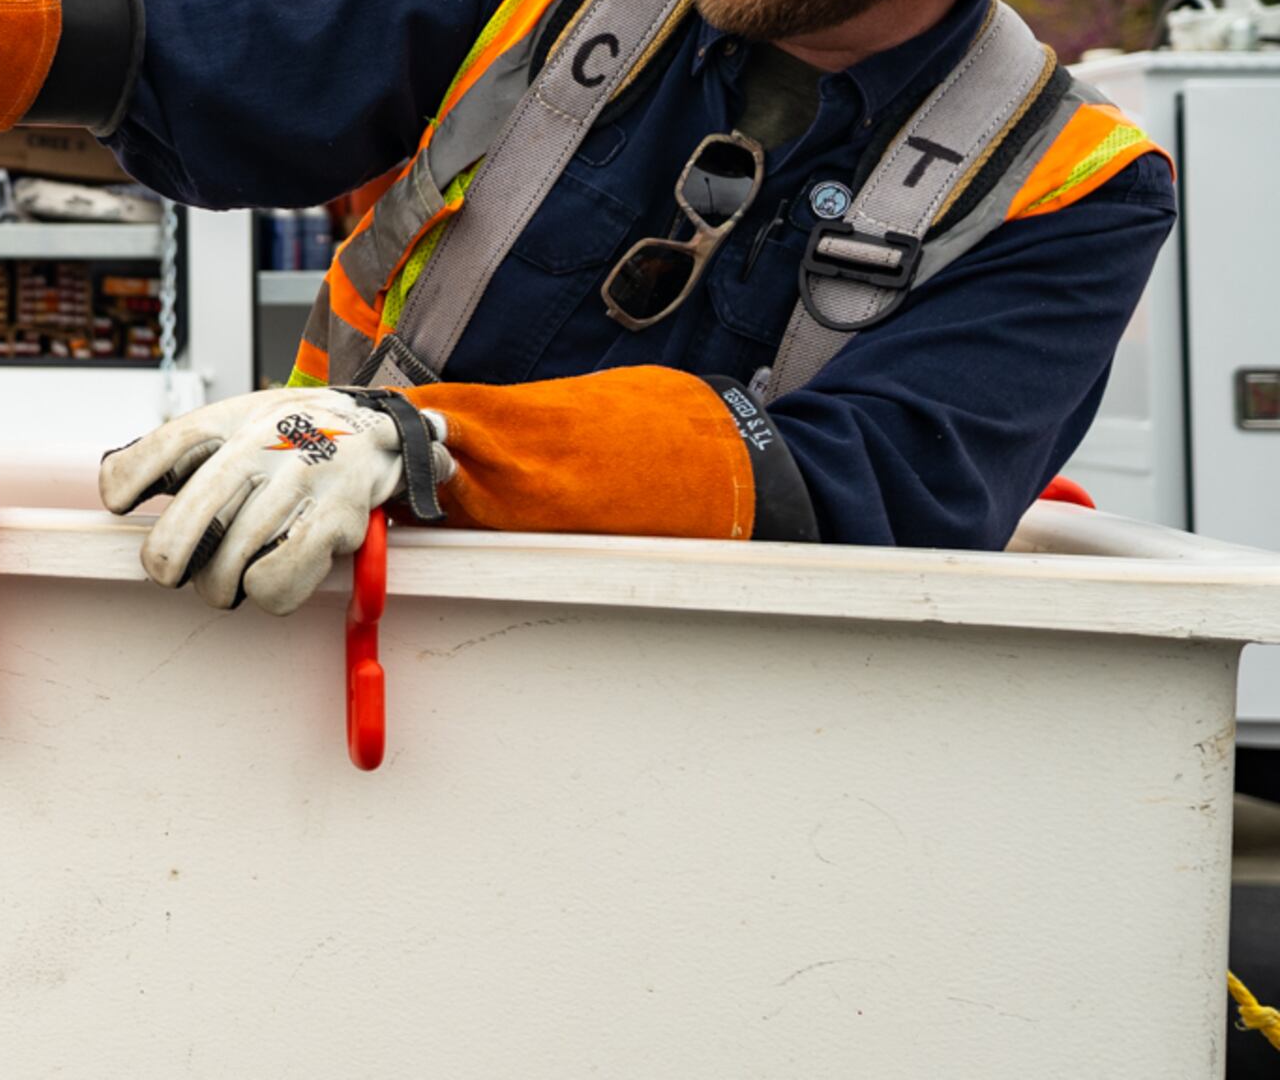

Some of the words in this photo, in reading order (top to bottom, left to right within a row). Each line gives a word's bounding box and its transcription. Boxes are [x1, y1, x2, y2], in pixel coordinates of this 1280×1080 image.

[572, 33, 620, 87] C
[903, 135, 964, 188] T
[276, 420, 333, 464] GRIPZ
[286, 413, 338, 456] POWER
